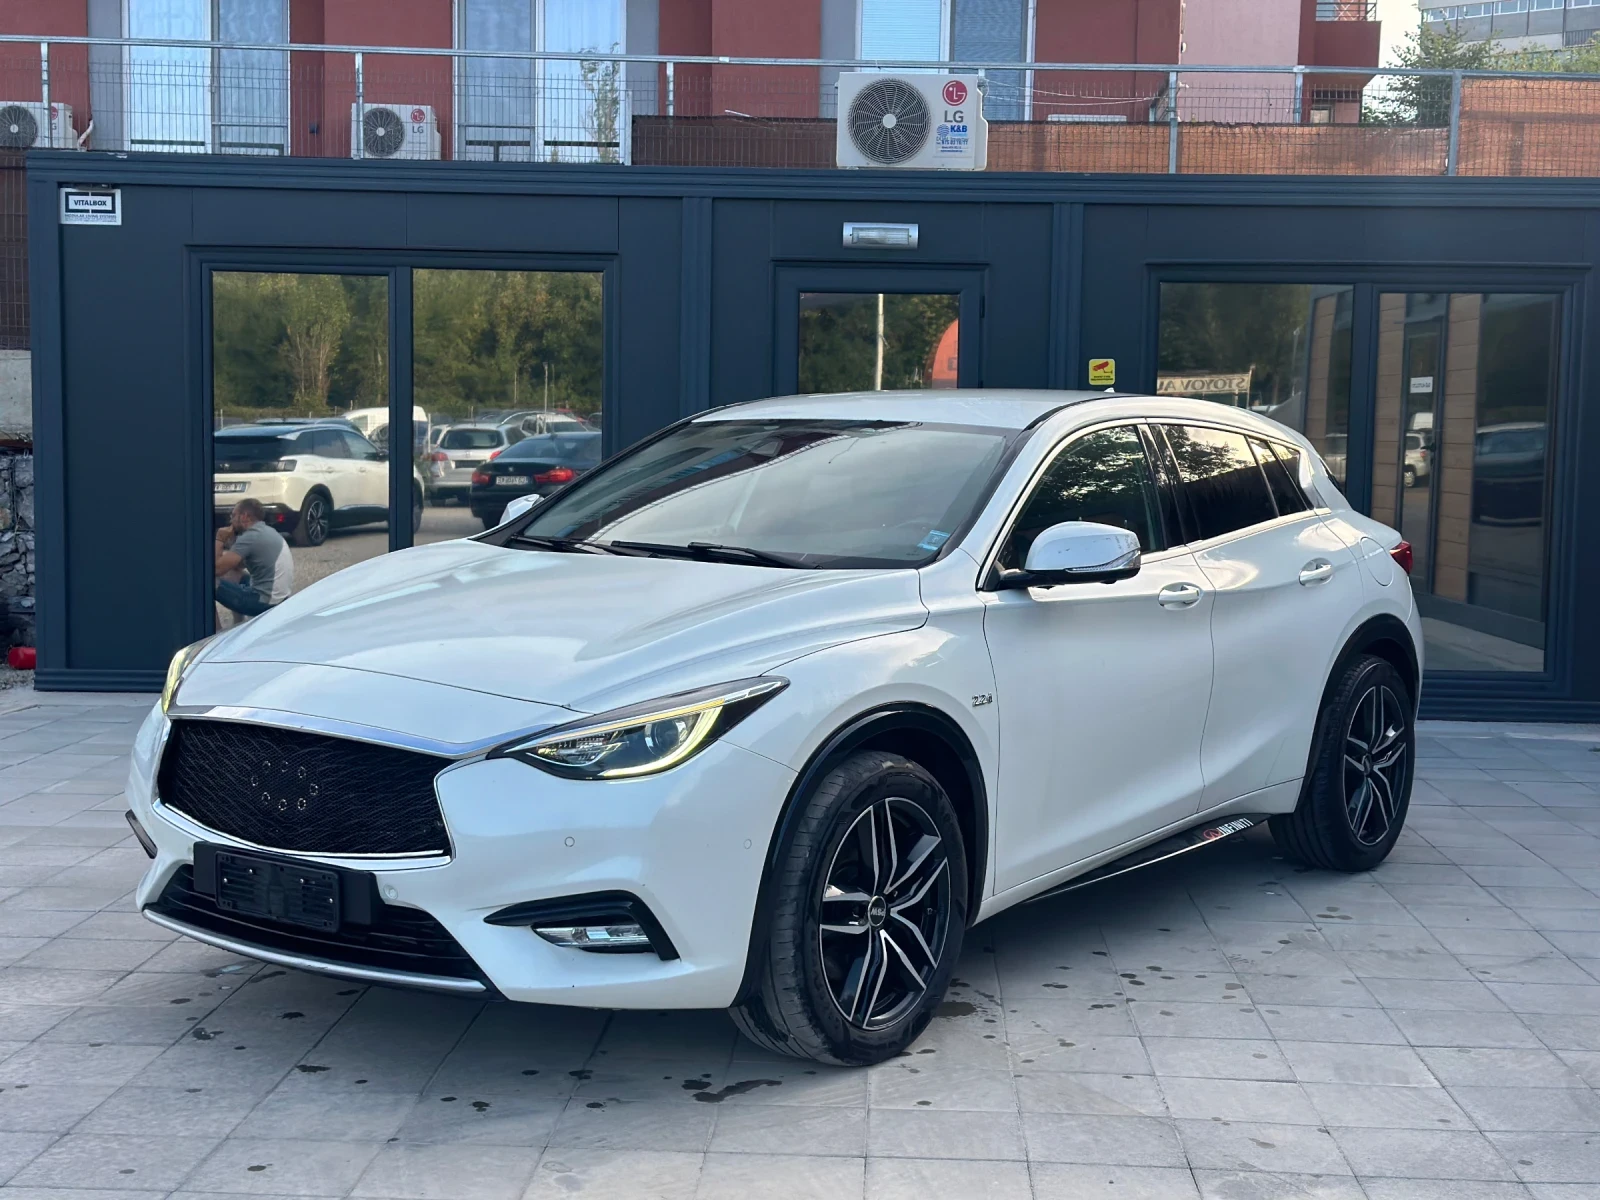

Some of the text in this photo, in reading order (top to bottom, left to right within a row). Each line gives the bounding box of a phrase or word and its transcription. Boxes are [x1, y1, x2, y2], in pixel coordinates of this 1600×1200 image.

[944, 109, 965, 124] LG
[412, 125, 424, 134] LG
[950, 124, 968, 133] K&B
[73, 199, 107, 207] VITALBOX
